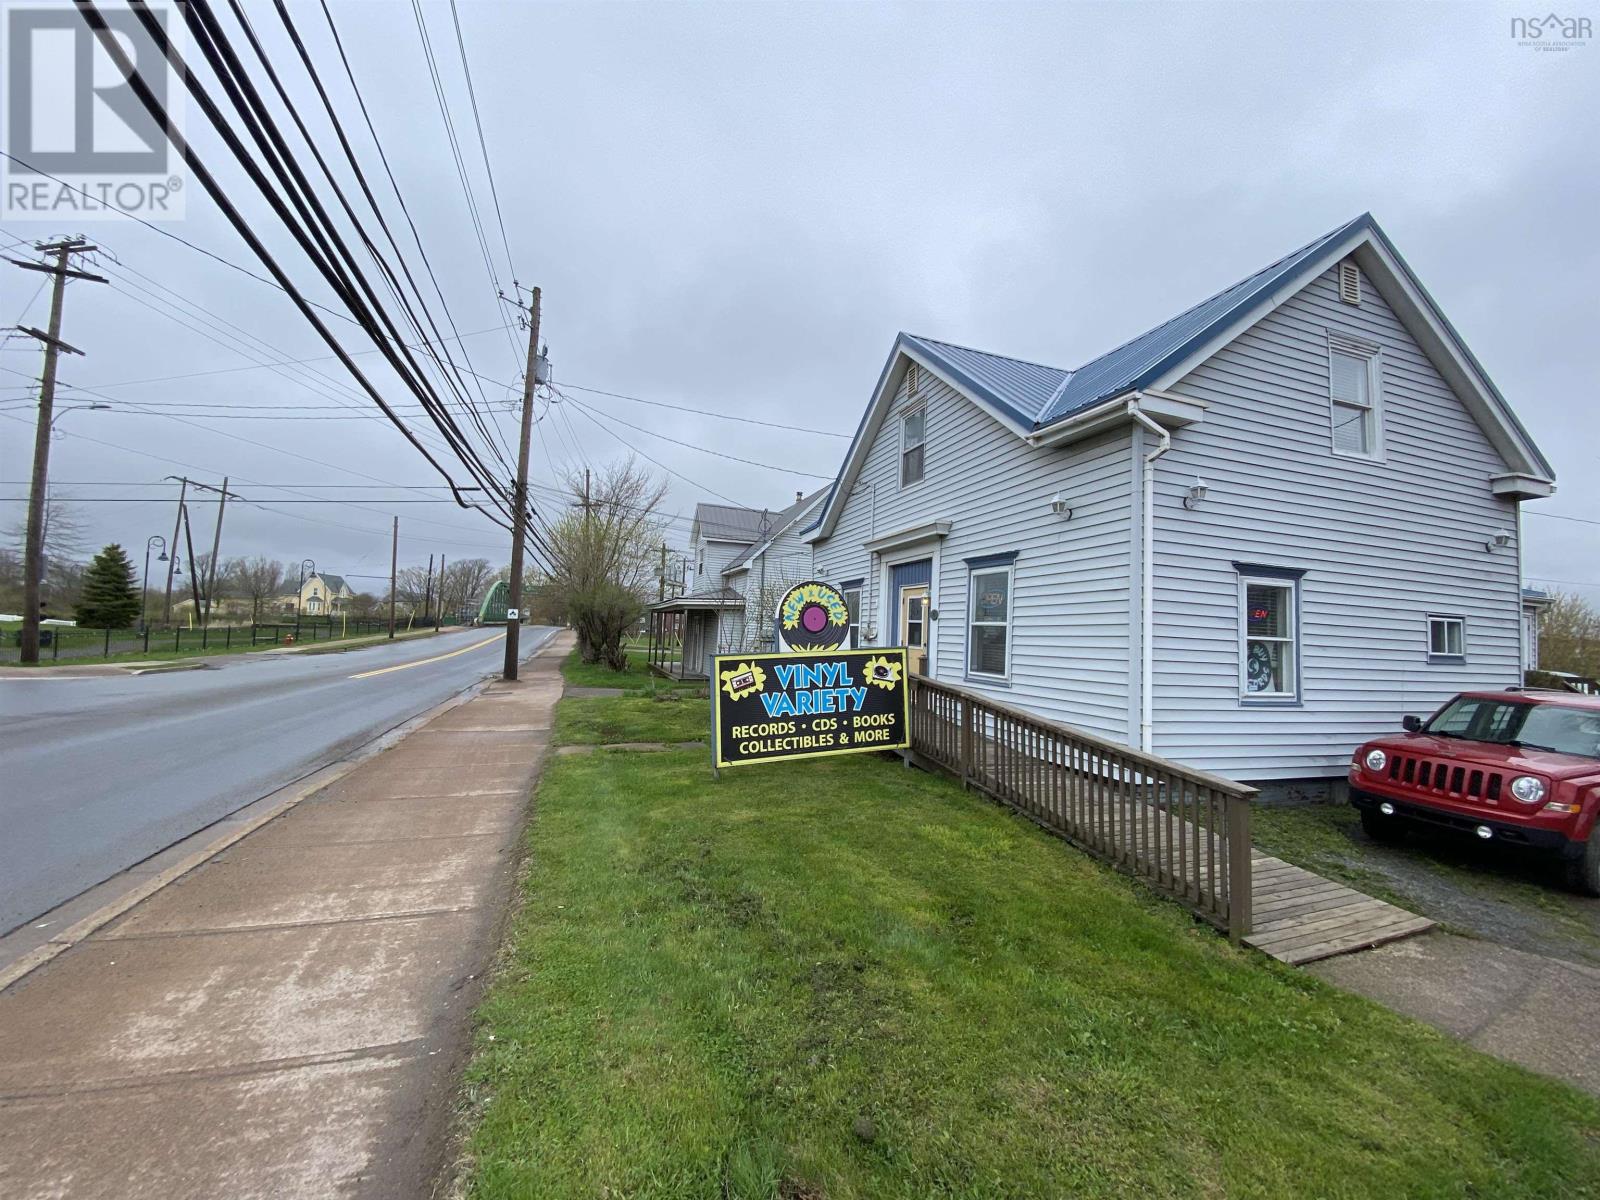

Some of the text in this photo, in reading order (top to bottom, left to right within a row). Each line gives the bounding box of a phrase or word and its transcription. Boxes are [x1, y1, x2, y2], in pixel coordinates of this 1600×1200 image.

[784, 591, 804, 621] NEW
[817, 589, 844, 620] USED
[774, 662, 853, 690] VINYL
[760, 687, 868, 718] VARIETY
[732, 713, 895, 739] RECORDS CDS BOOKS
[739, 729, 890, 754] COLLECTIBLES & MORE
